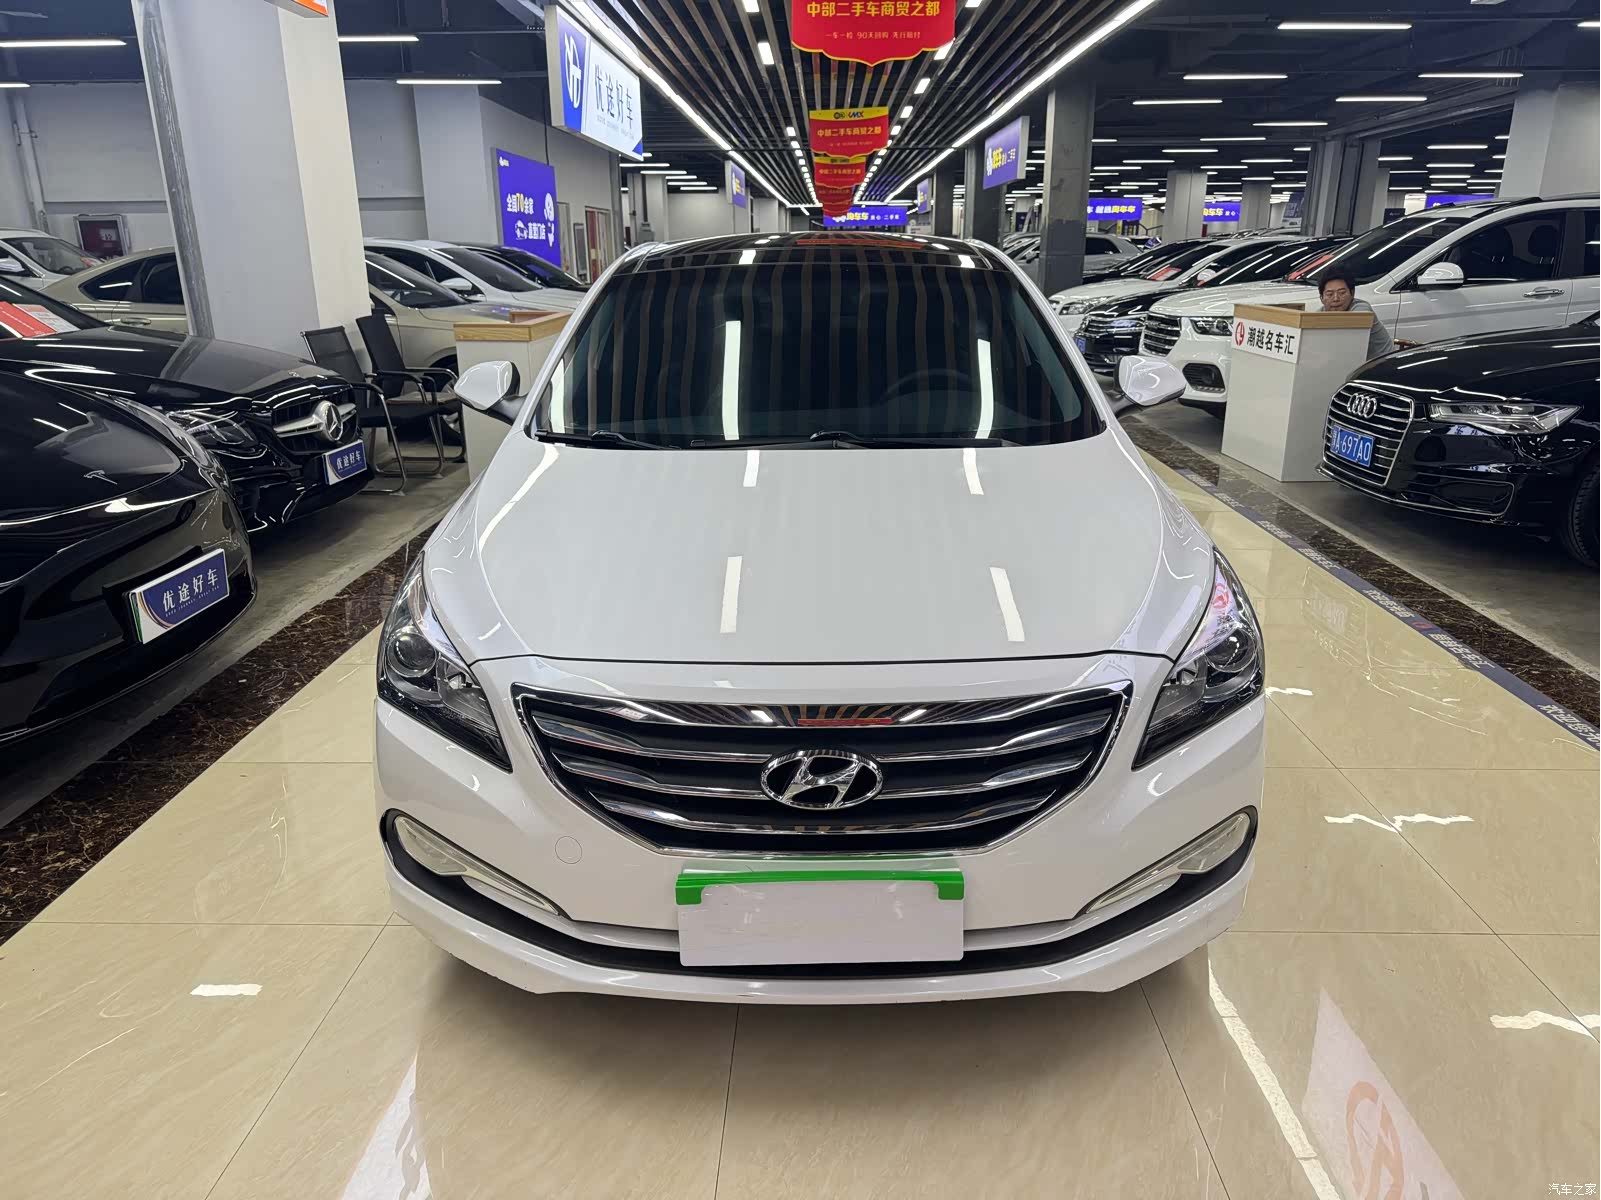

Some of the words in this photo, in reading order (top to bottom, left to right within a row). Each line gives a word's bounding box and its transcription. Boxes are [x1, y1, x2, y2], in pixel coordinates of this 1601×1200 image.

[807, 1, 940, 17] 中部二手车商贸之都
[595, 64, 633, 130] 优途好车
[817, 126, 882, 137] 中部二手车商贸之都
[507, 193, 534, 215] 全国70余家
[1247, 326, 1295, 355] 潮越名车汇
[337, 450, 361, 470] 优途好车
[163, 568, 219, 612] 优途好车
